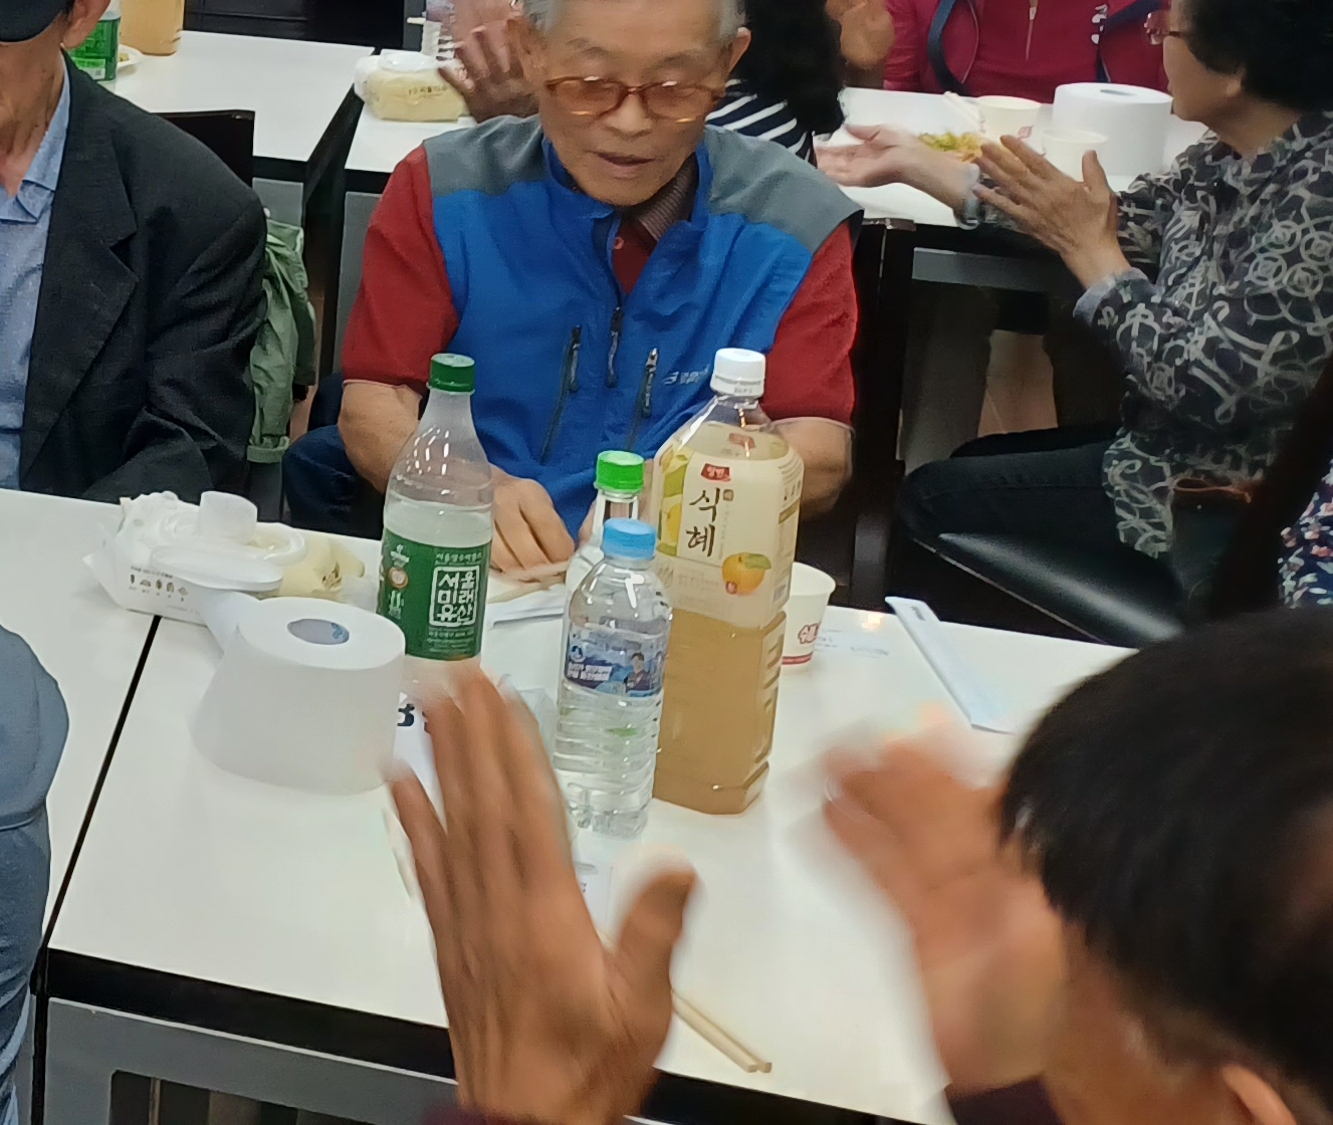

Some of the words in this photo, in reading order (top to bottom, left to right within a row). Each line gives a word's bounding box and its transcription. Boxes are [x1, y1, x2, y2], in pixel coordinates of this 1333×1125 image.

[685, 487, 721, 557] 식혜
[438, 571, 475, 590] 서울
[437, 589, 474, 604] 미래
[436, 604, 473, 623] 유산
